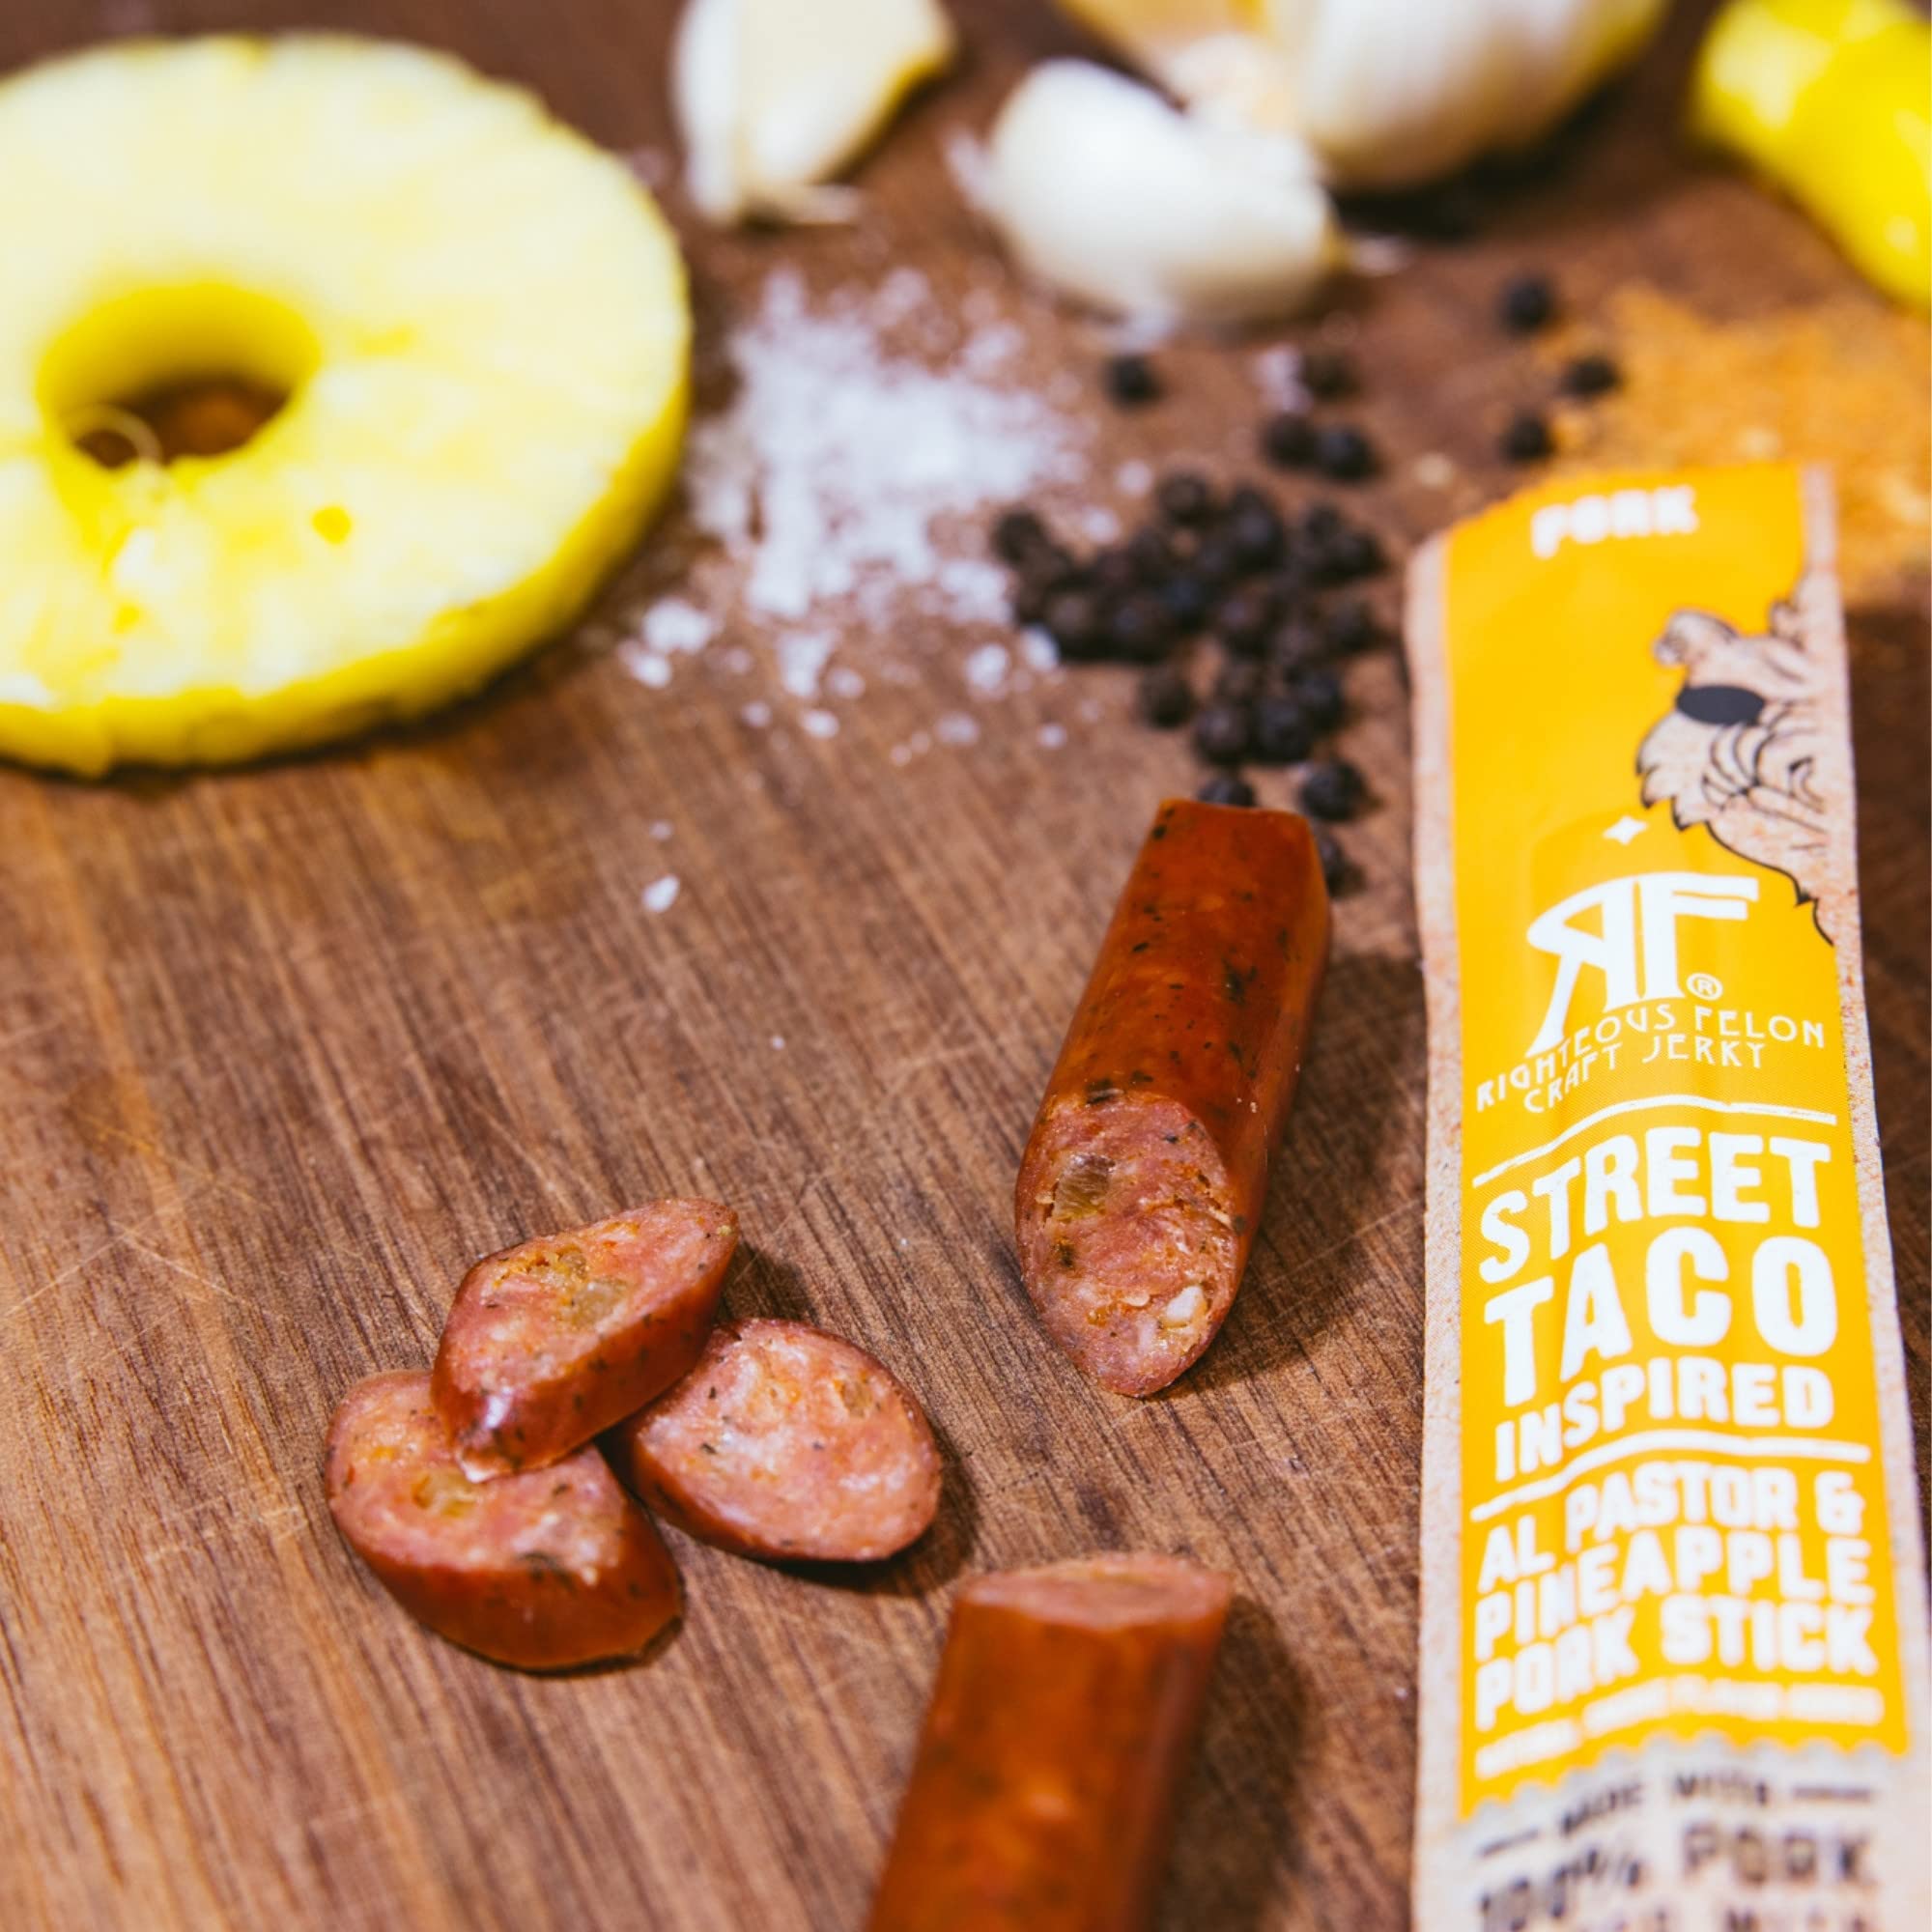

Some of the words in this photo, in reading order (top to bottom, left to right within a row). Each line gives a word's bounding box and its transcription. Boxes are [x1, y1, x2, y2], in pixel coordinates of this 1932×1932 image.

[1530, 486, 1698, 559] PORK
[1476, 1005, 1676, 1112] RIGHTEOUS
[1694, 1006, 1825, 1048] FELON
[1523, 1042, 1623, 1113] CRAFT
[1642, 1034, 1765, 1068] JERKY
[1479, 1126, 1831, 1283] STREET
[1483, 1226, 1838, 1407] TACO
[1494, 1356, 1834, 1483] INSPIRED
[1474, 1524, 1876, 1662] PINEAPPLE
[1477, 1514, 1556, 1595] AL
[1565, 1461, 1799, 1553] PASTOR
[1814, 1470, 1865, 1536] &
[1474, 1605, 1639, 1732] PORK
[1660, 1594, 1879, 1676] STICK
[1683, 1823, 1878, 1886] PORK
